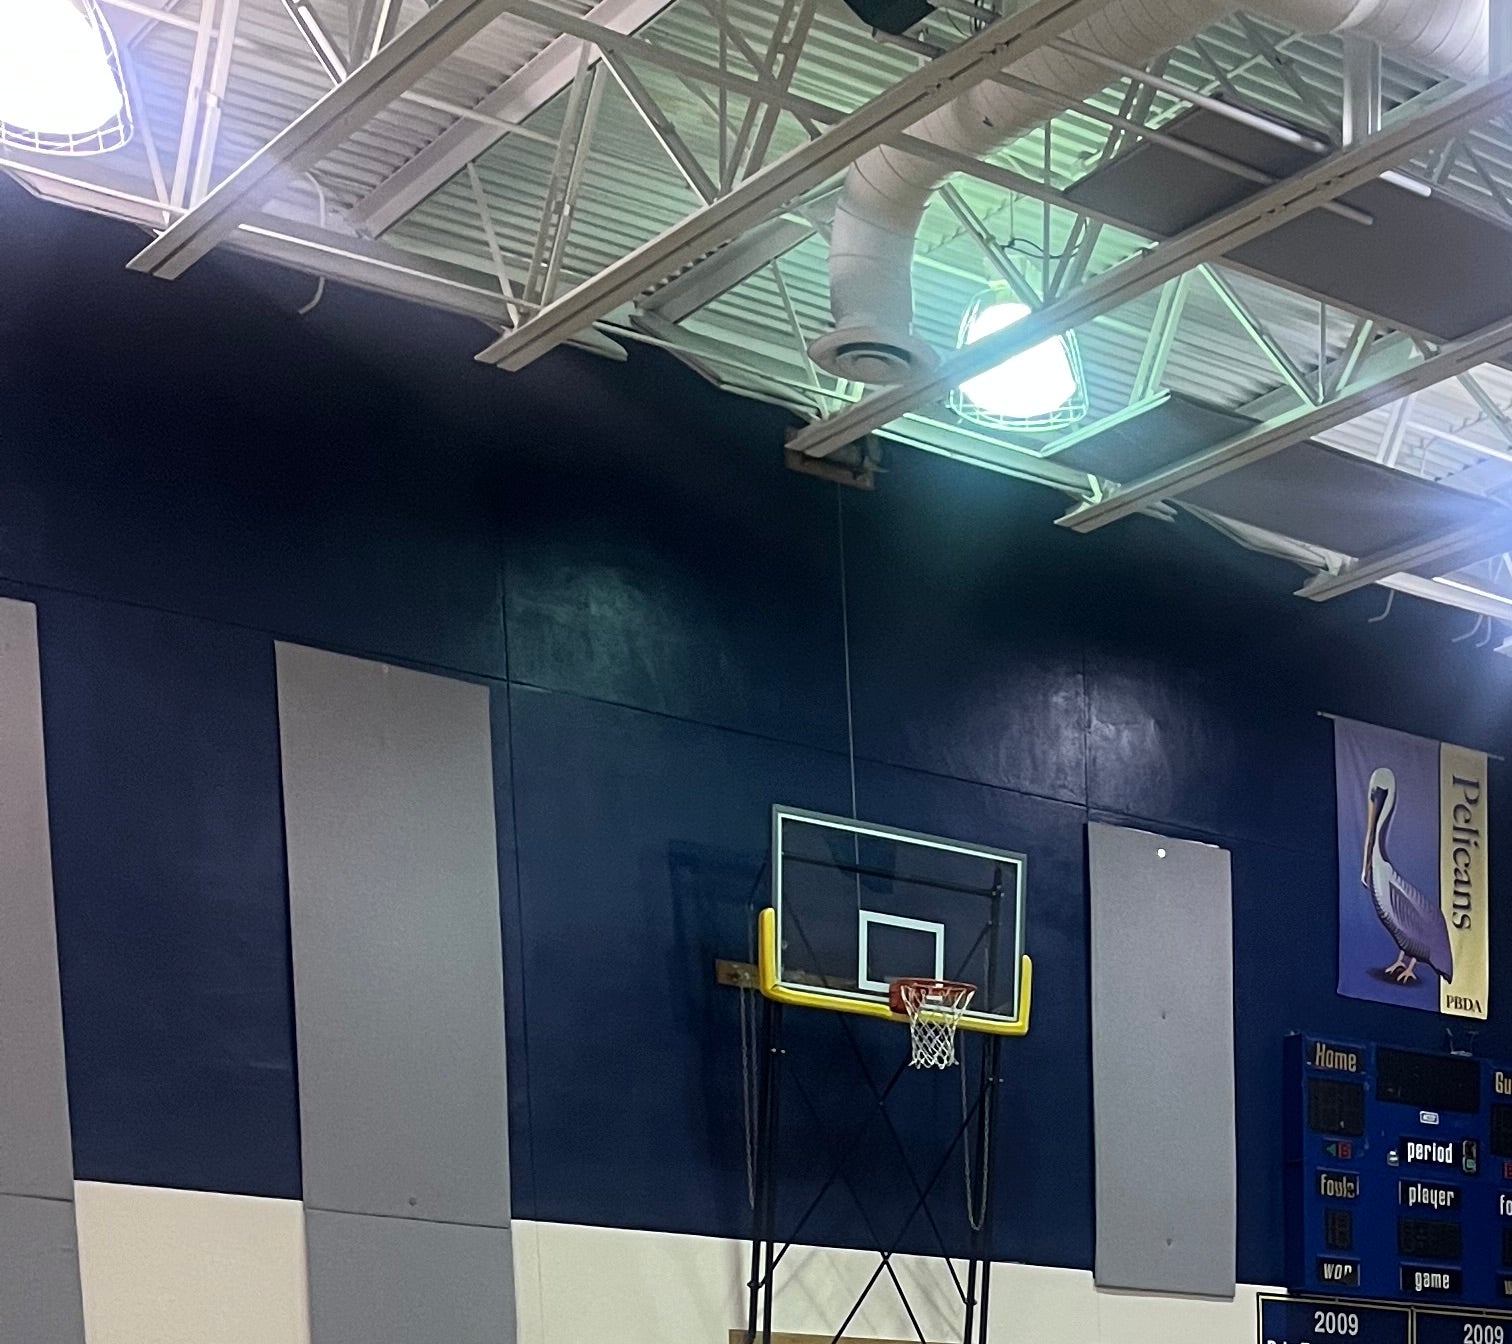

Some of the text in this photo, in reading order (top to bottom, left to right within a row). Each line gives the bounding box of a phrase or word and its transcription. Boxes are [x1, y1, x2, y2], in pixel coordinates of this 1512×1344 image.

[1452, 774, 1481, 931] Pelicans
[1446, 994, 1482, 1013] PBDA
[1315, 1042, 1357, 1073] Home
[1407, 1142, 1453, 1164] period
[1409, 1183, 1455, 1210] player
[1415, 1271, 1450, 1292] game
[1314, 1311, 1359, 1336] 2009
